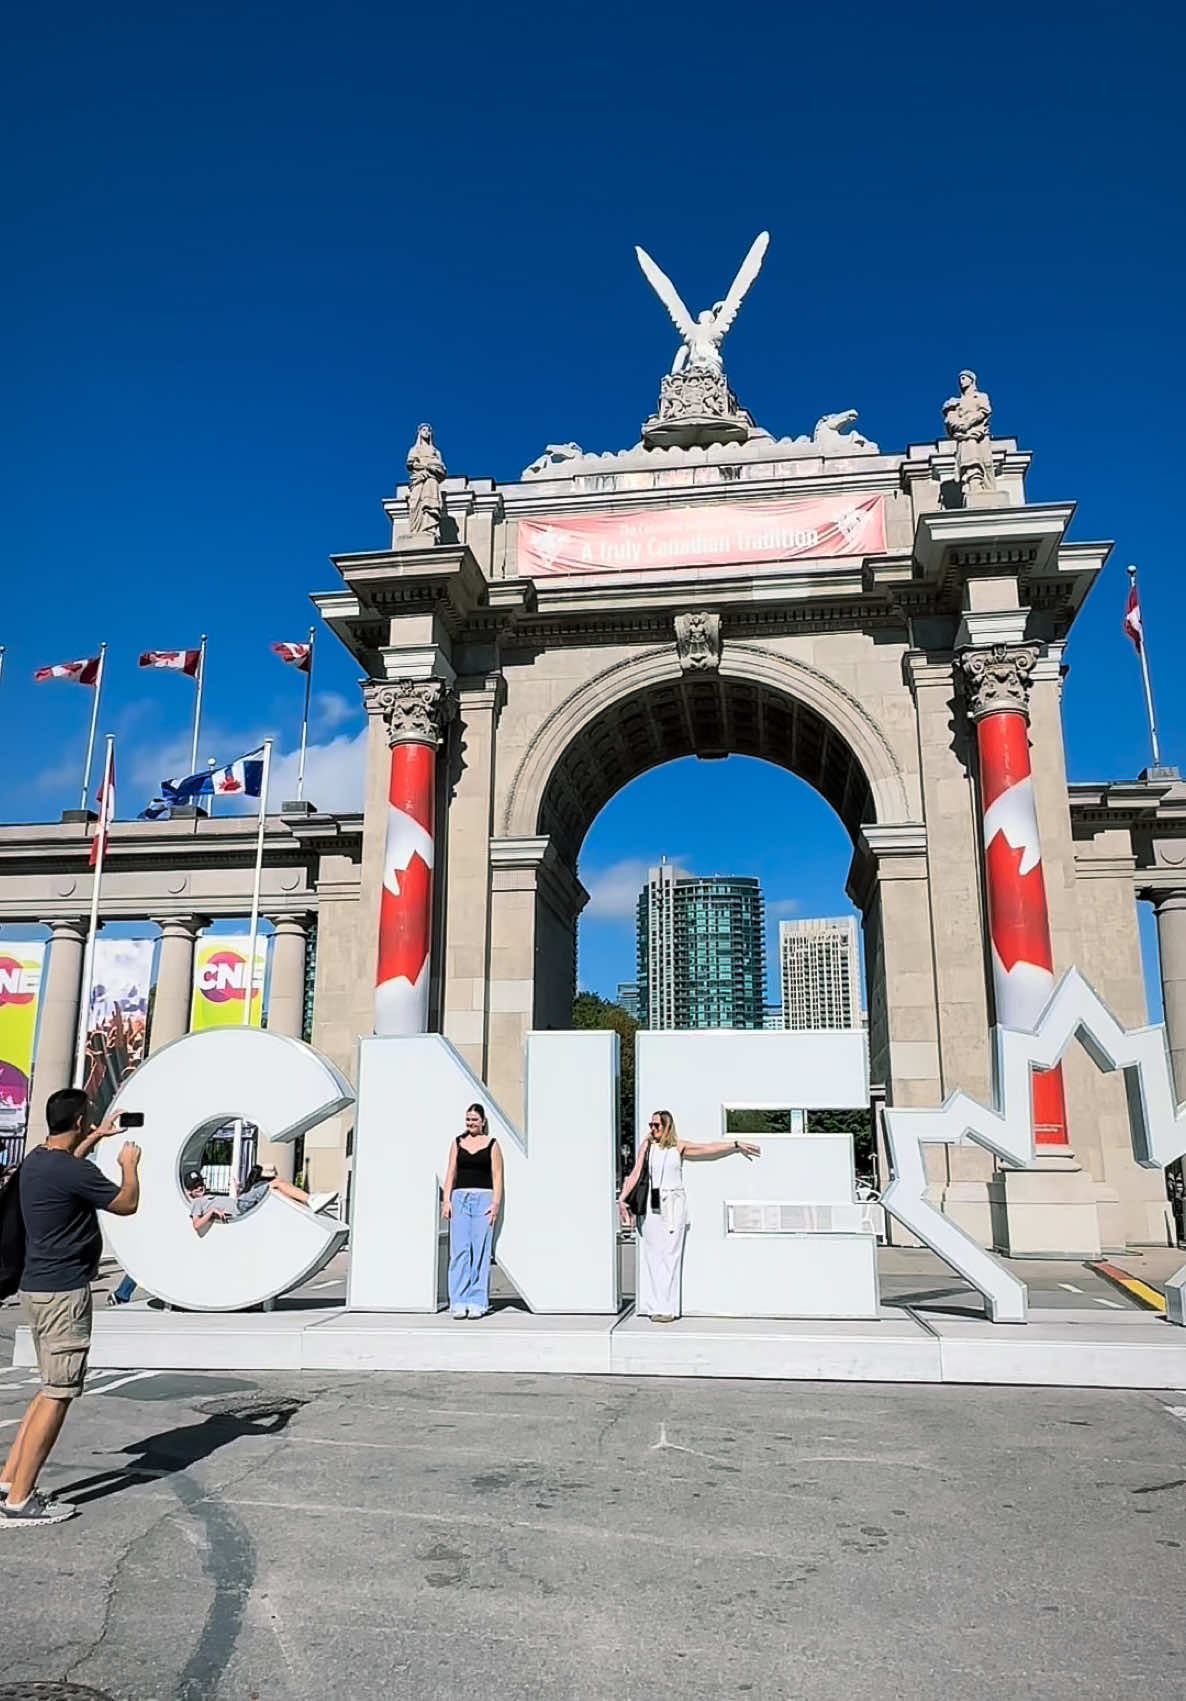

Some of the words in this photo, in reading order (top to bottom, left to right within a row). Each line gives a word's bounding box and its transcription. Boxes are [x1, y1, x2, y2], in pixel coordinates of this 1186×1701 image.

[582, 541, 594, 561] A
[600, 540, 641, 561] Truly
[646, 533, 730, 558] Canadian
[736, 526, 819, 551] Tradition
[0, 967, 42, 994] NE
[95, 1027, 880, 1319] CNE
